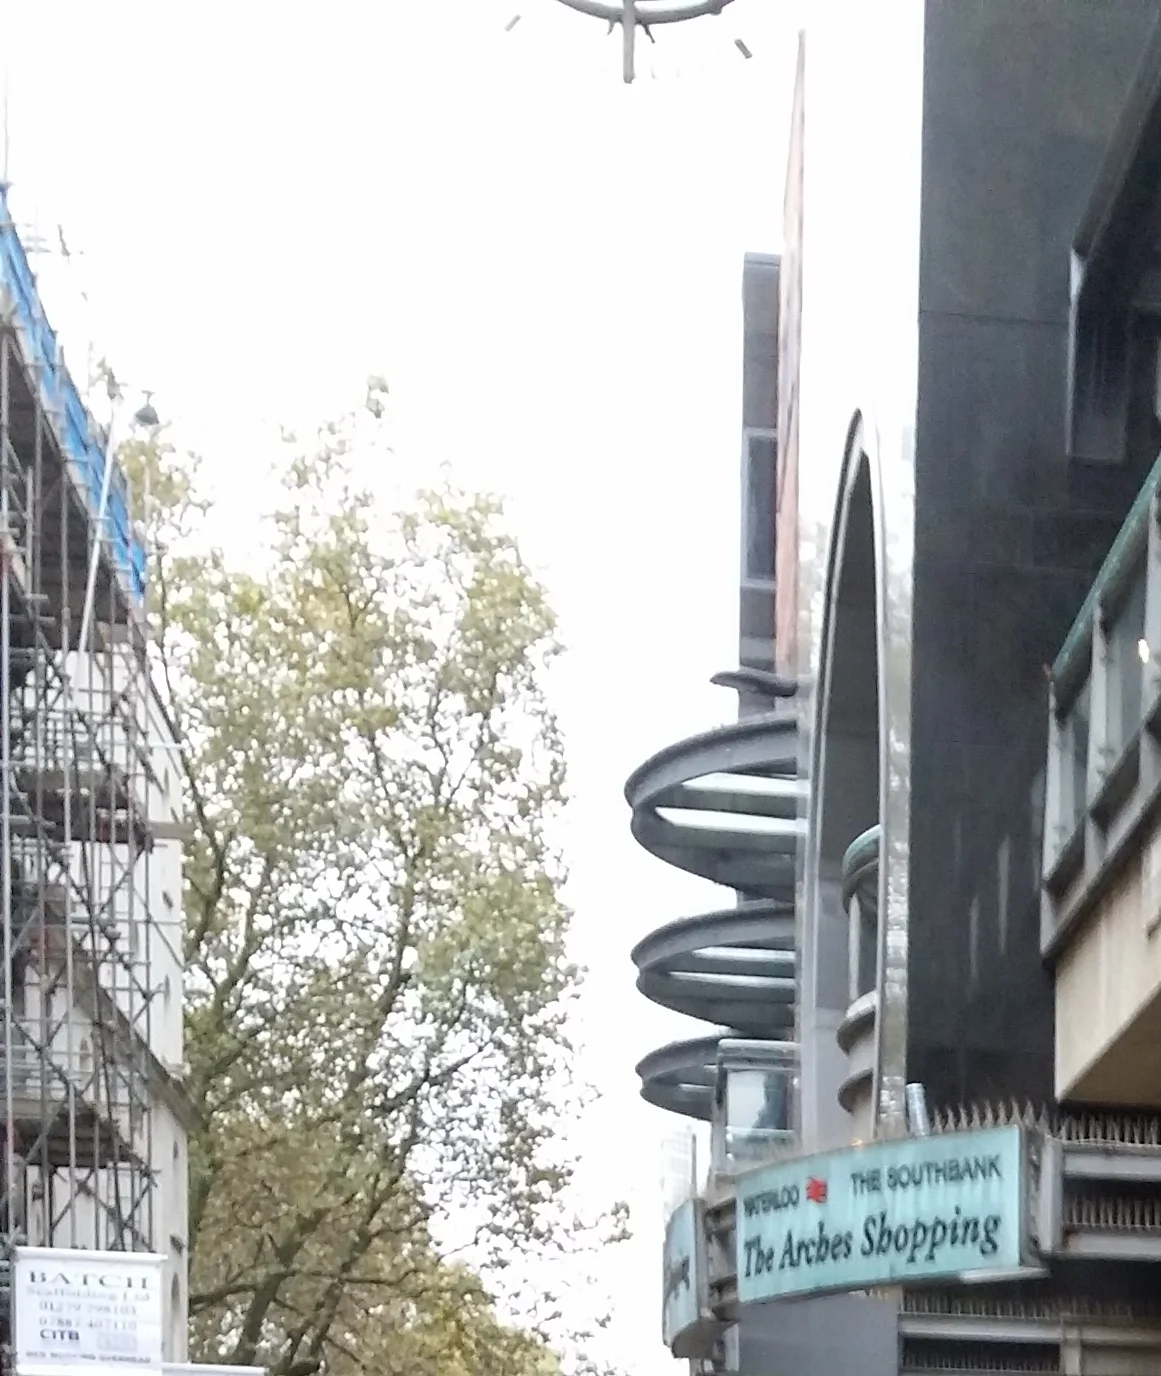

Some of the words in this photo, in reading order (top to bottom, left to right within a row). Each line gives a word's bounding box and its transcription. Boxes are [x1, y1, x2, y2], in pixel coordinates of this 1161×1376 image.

[851, 1168, 882, 1196] THE
[887, 1155, 1002, 1191] SOUTHBANK
[744, 1234, 775, 1278] The
[779, 1220, 853, 1270] Arches
[861, 1206, 1001, 1263] Shopping
[29, 1270, 150, 1289] BATCH
